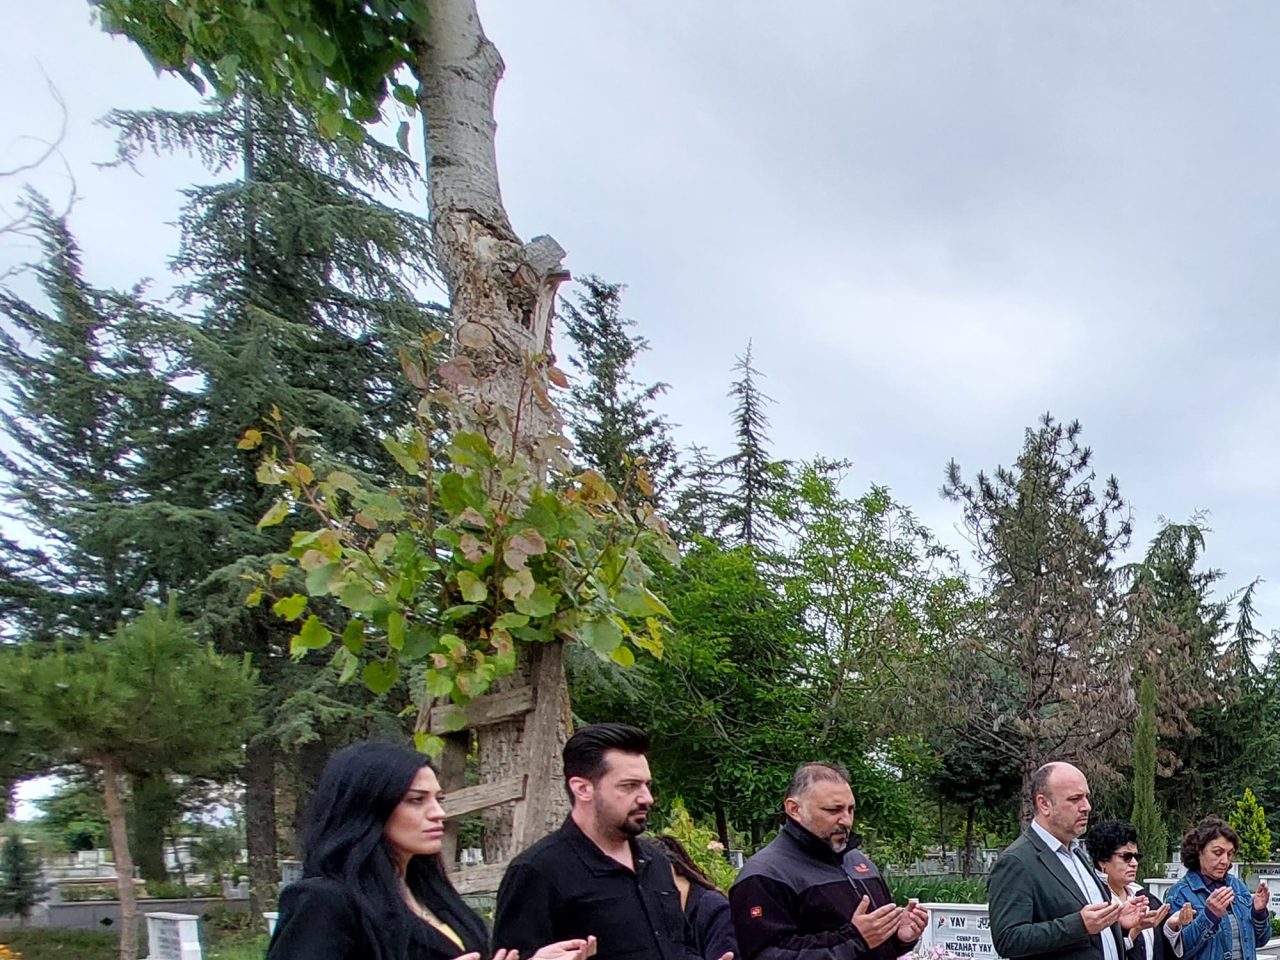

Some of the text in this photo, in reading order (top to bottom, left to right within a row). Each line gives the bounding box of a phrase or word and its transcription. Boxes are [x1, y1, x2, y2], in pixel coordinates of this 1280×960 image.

[950, 917, 965, 927] YAY
[946, 942, 992, 952] NEZAHAT YAY
